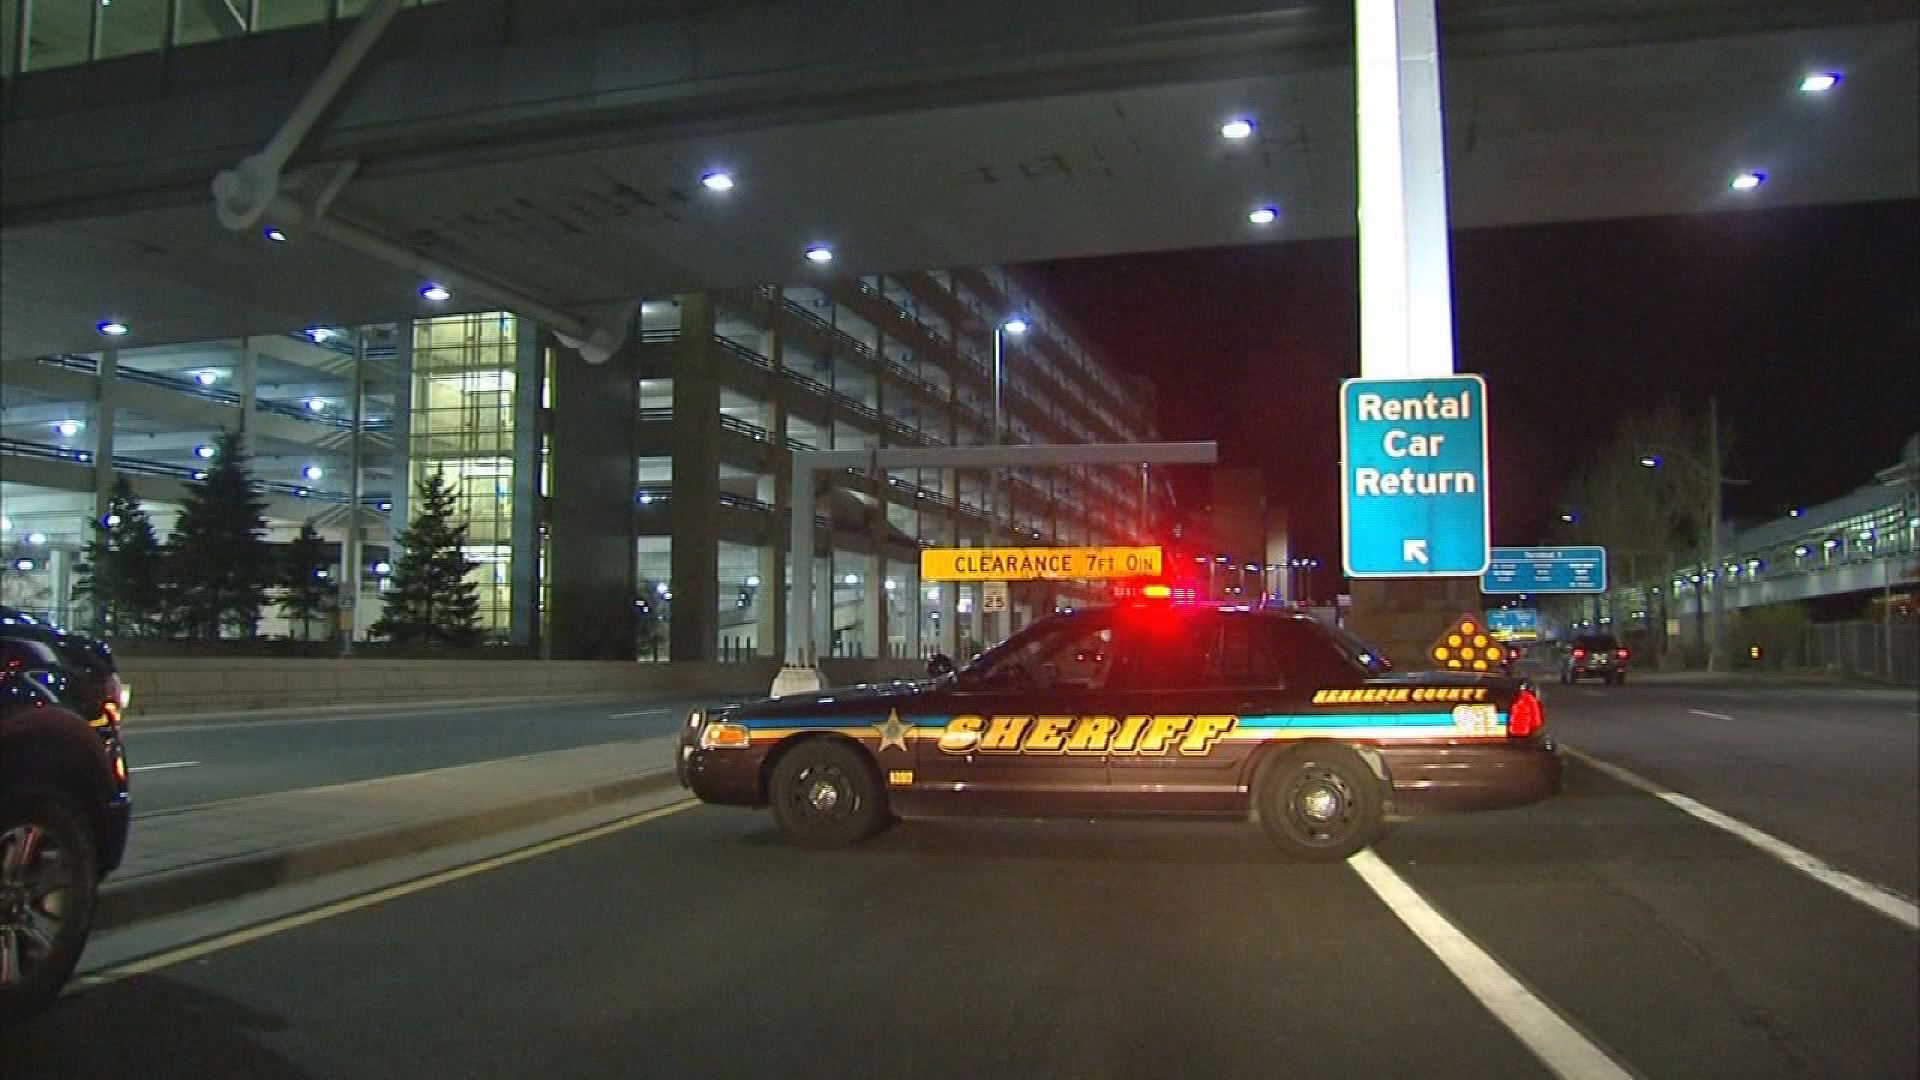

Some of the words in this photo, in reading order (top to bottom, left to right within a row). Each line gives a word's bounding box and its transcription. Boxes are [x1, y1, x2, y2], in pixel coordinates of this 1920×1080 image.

[1357, 391, 1471, 421] Rental
[1383, 430, 1445, 457] Car
[1355, 468, 1477, 496] Return
[954, 556, 1072, 572] CLEARANCE
[1411, 687, 1489, 702] COUNTY
[936, 713, 1239, 756] SHERIFF
